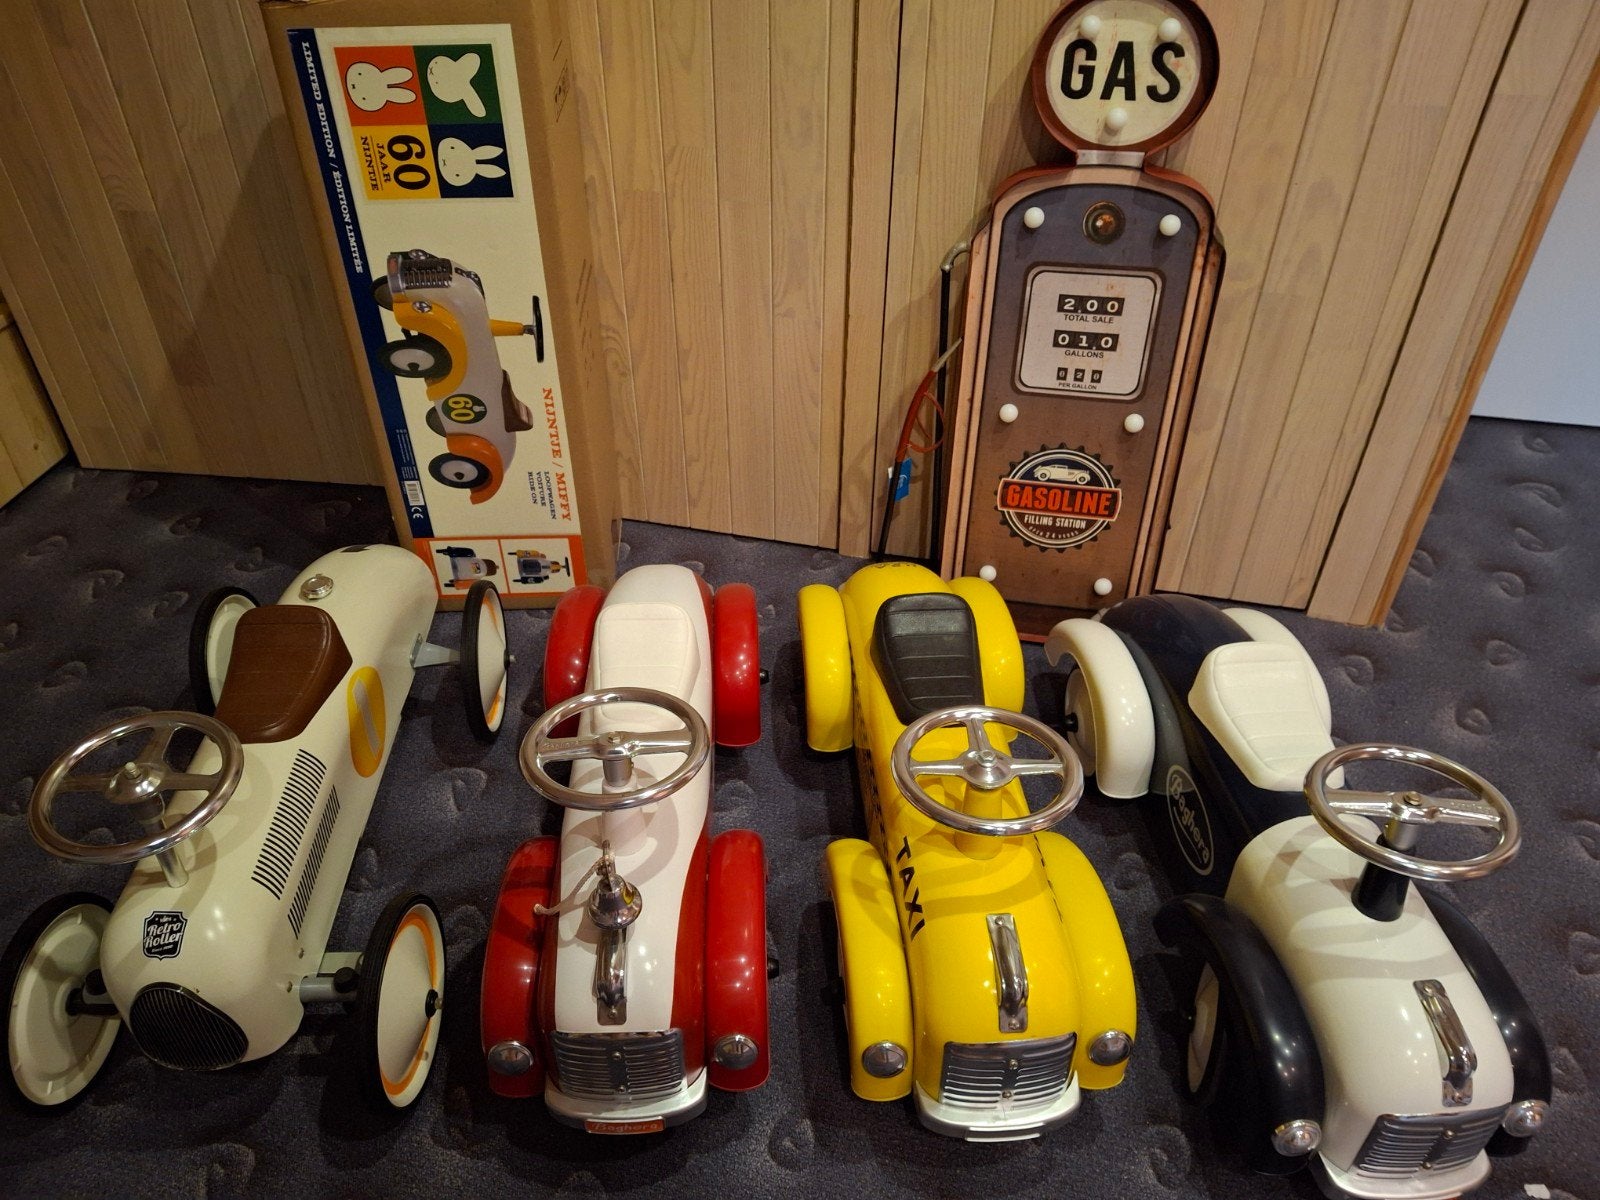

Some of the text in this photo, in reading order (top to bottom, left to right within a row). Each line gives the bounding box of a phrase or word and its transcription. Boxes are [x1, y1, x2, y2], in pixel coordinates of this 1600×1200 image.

[1060, 38, 1185, 103] GAS
[302, 41, 322, 101] LIMITED
[316, 101, 336, 158] EDITION
[333, 169, 353, 222] ÉDITION
[345, 219, 364, 274] LIMITÉE
[361, 135, 379, 191] NIJNTJE
[377, 143, 391, 183] JAAR
[387, 135, 431, 190] 60
[1063, 298, 1119, 314] 2.00
[1064, 314, 1114, 324] TOTAL SALE
[1064, 350, 1104, 359] GALLONS
[448, 396, 475, 422] 60
[543, 387, 562, 459] NIJNTJE
[555, 472, 572, 521] MIFFY
[536, 471, 547, 507] VOITURE
[544, 471, 557, 520] LOOPWAGEN
[1006, 484, 1112, 515] GASOLINE
[1024, 514, 1087, 529] FILLING STATION
[896, 836, 926, 942] TAXI
[143, 931, 183, 949] Roller
[147, 922, 183, 936] Retro
